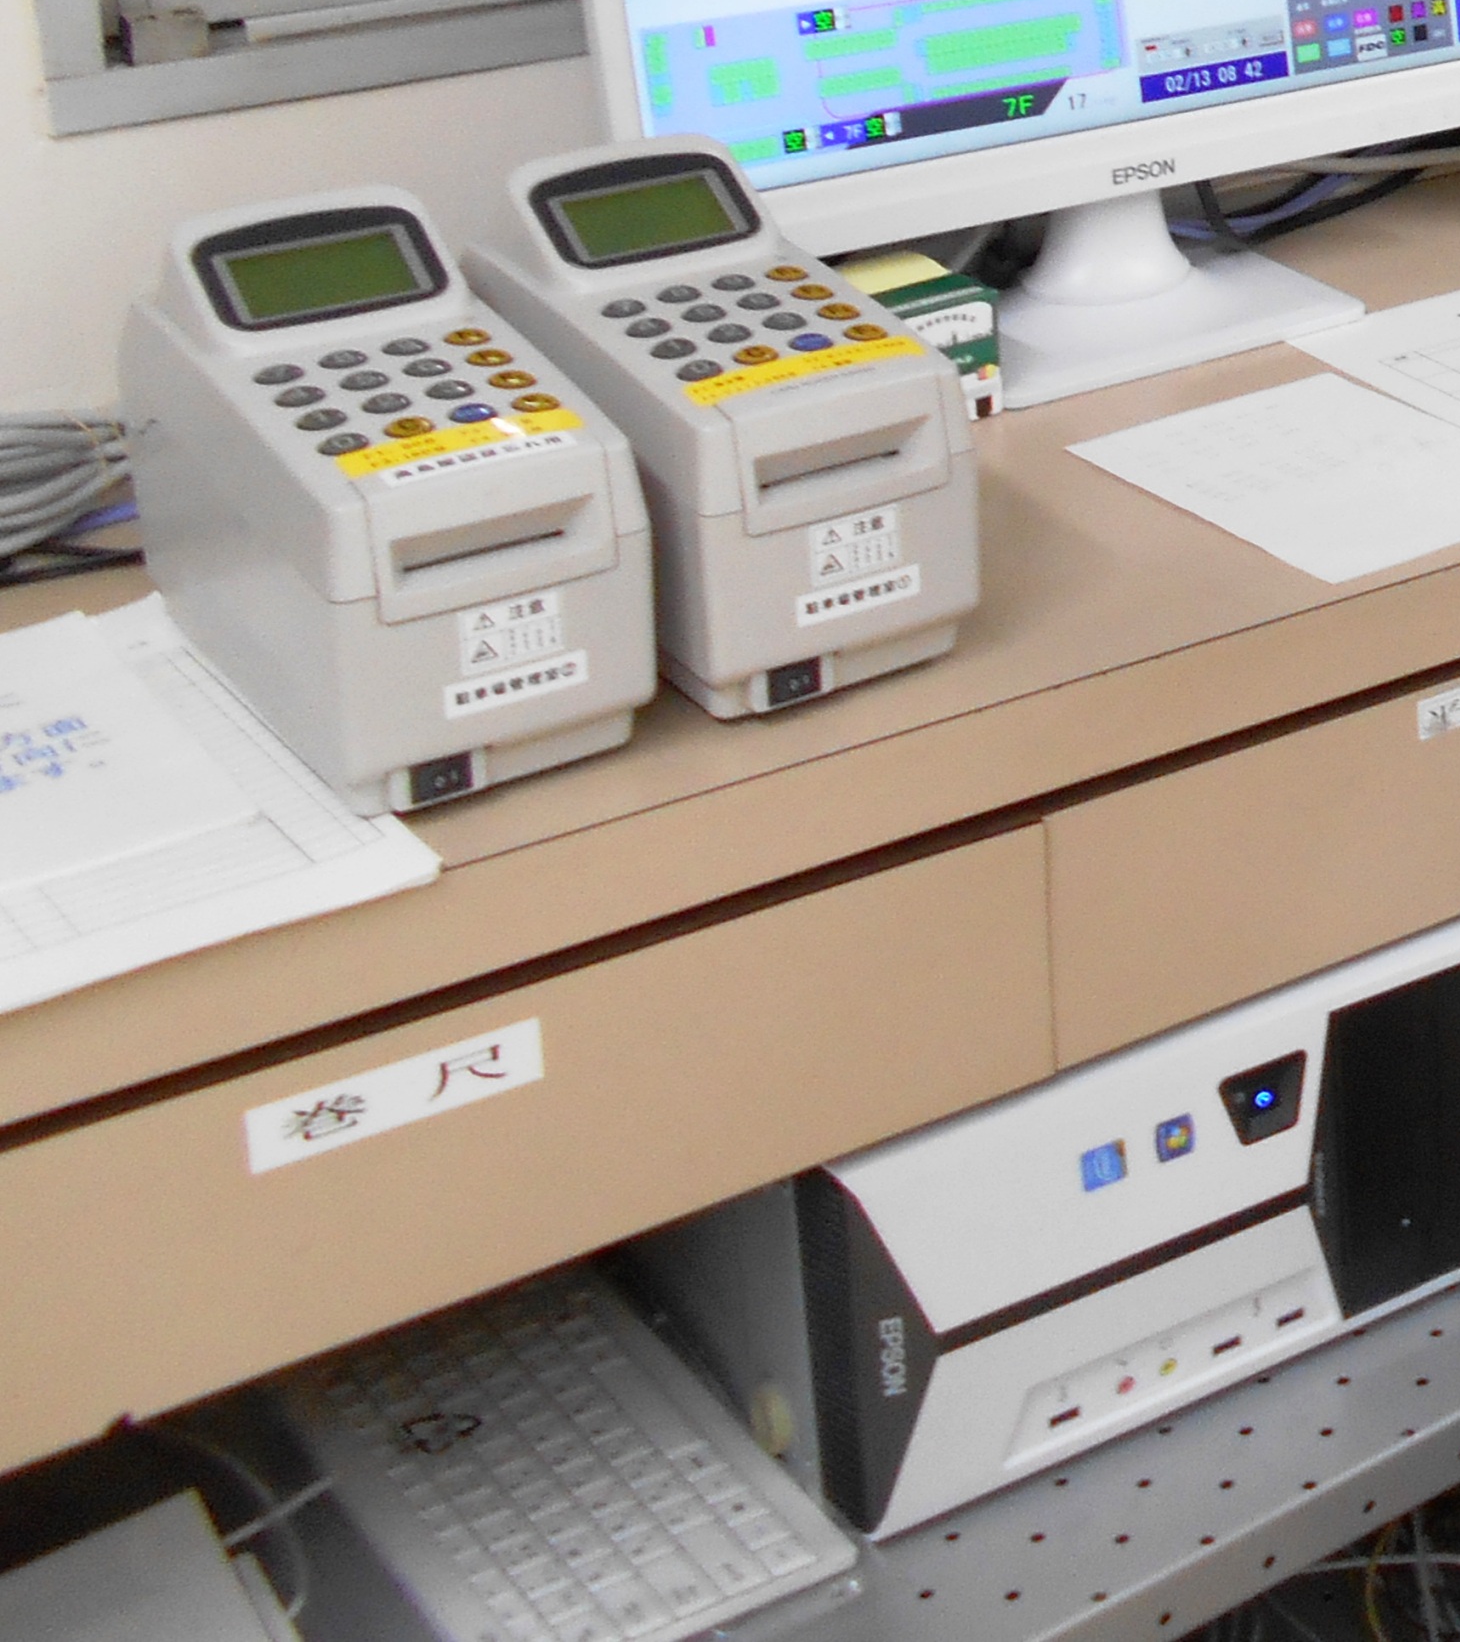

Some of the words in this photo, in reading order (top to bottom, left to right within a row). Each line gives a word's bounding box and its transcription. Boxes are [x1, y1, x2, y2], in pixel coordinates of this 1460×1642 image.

[1165, 71, 1210, 93] 02/13
[1244, 60, 1263, 78] 42
[1003, 95, 1034, 118] 7F
[1068, 95, 1087, 110] 17
[1112, 159, 1177, 185] EPSON
[852, 515, 884, 538] 注意
[507, 598, 547, 621] 注意
[879, 1317, 907, 1397] EPSON
